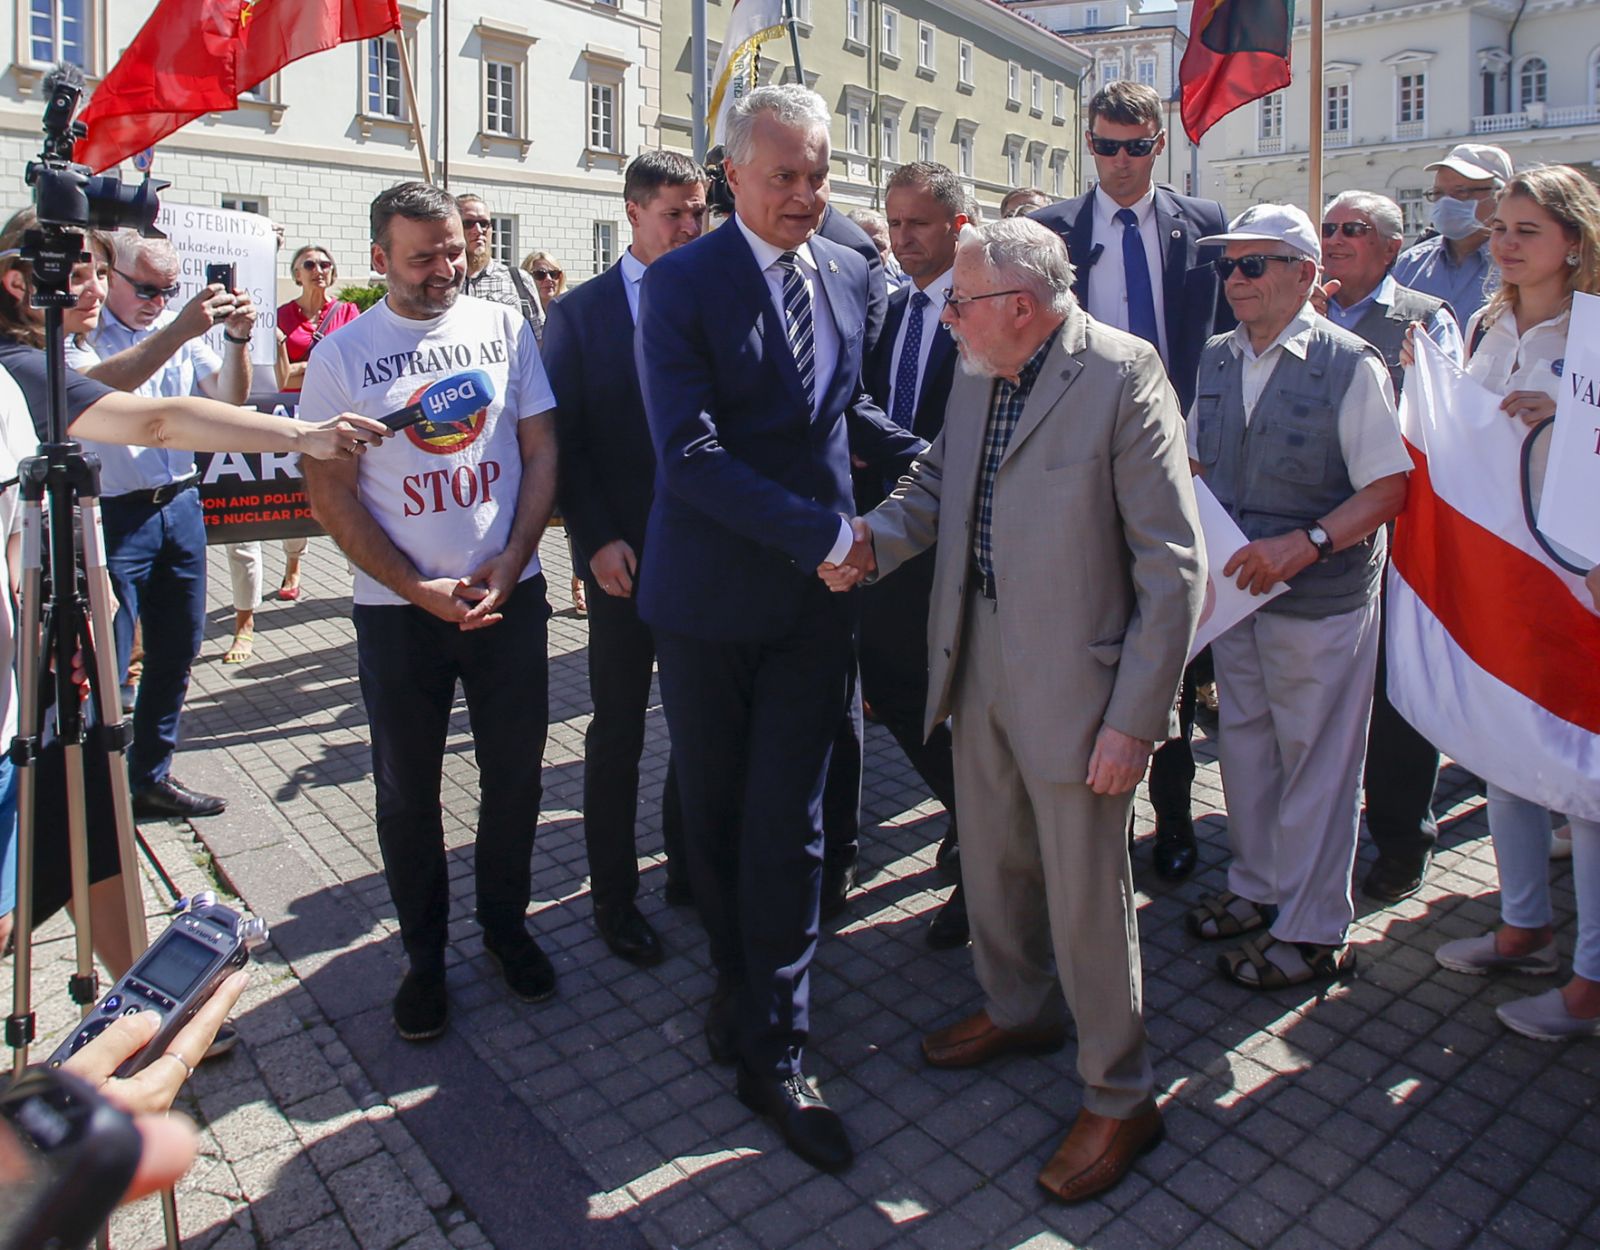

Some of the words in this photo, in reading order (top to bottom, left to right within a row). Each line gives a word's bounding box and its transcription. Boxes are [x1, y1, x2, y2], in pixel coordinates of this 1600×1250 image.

[184, 210, 265, 237] STEBINTYS
[362, 343, 472, 388] ASTRAVO
[479, 340, 507, 365] AE
[428, 380, 477, 415] Delfi
[202, 498, 226, 509] ON
[229, 495, 260, 508] AND
[402, 460, 501, 517] STOP
[203, 514, 221, 526] TS
[223, 509, 291, 525] NUCLEAR
